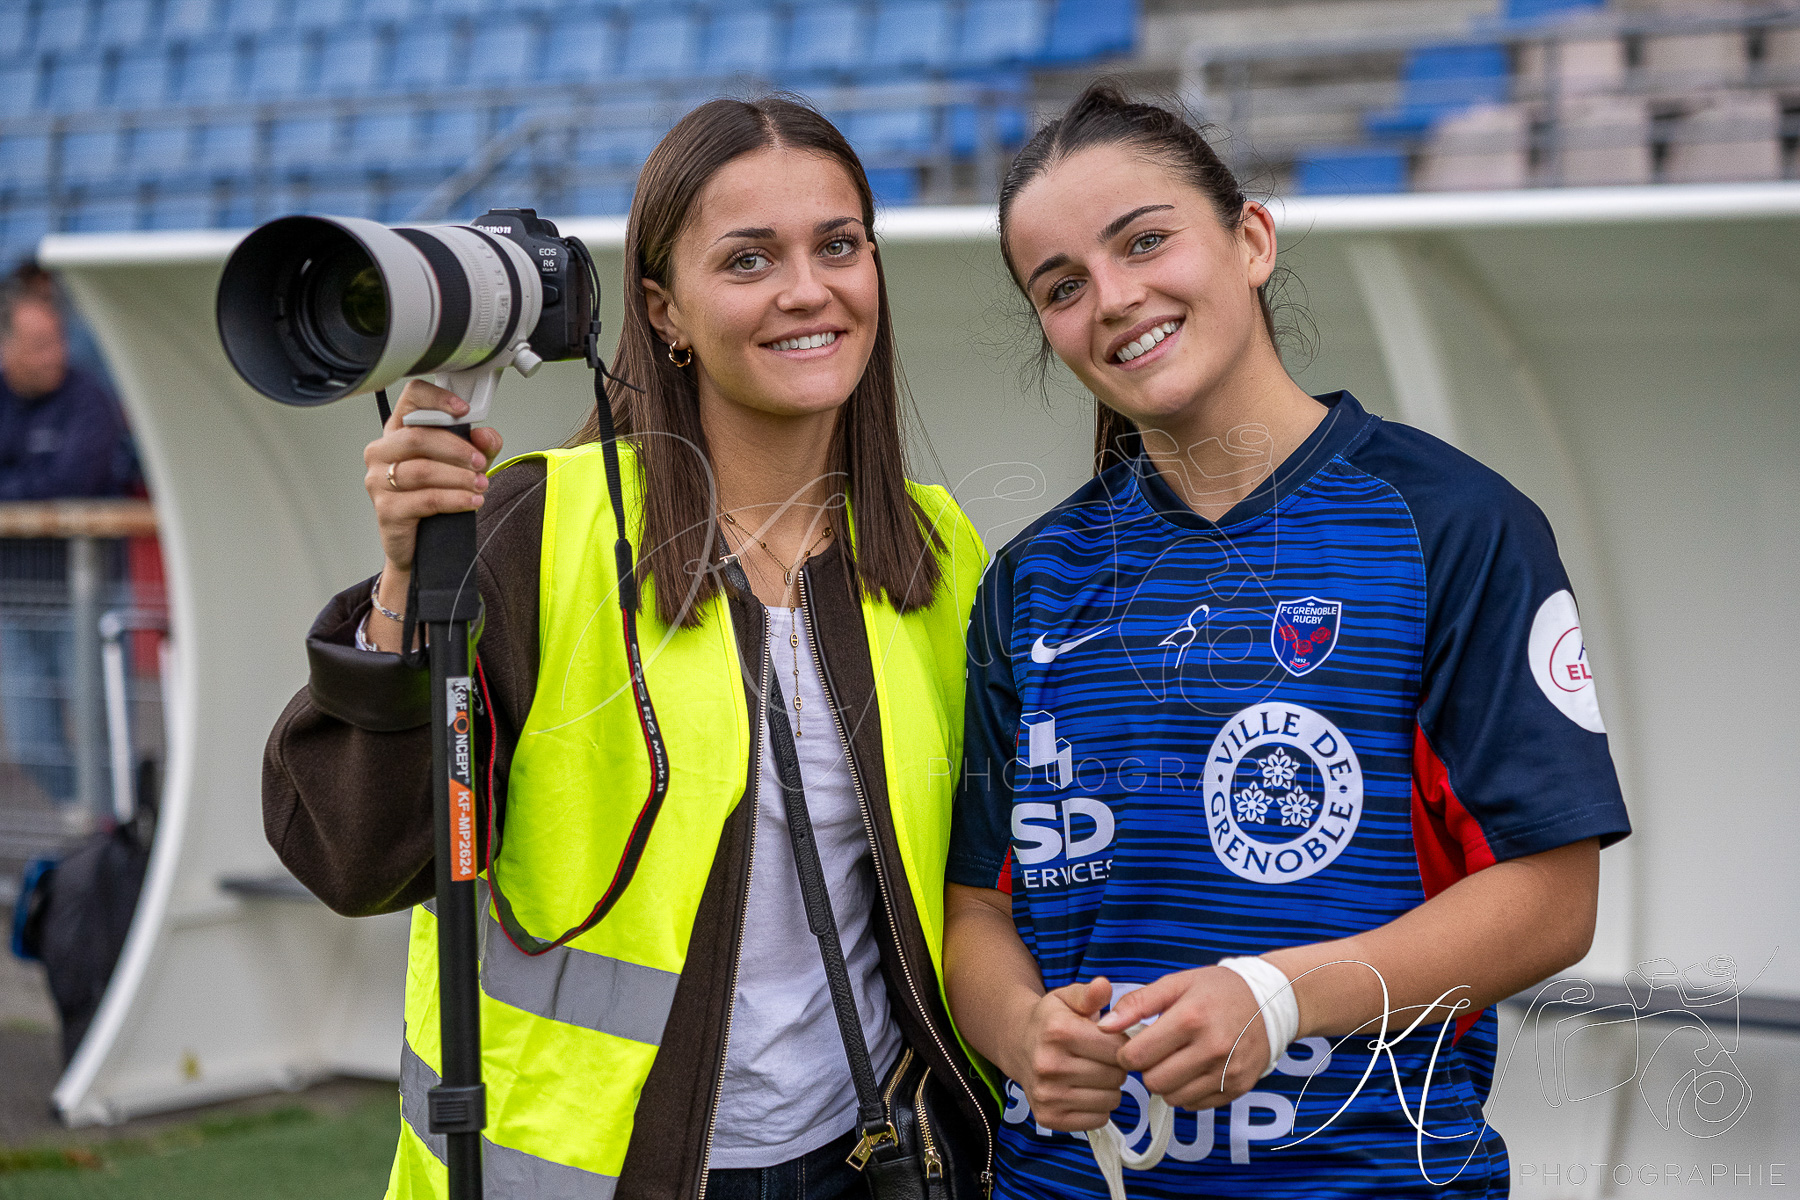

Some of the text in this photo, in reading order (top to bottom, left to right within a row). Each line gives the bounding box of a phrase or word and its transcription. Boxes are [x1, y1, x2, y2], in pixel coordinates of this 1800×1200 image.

[538, 247, 557, 256] EOS
[543, 259, 555, 267] R6
[1292, 615, 1323, 624] RUGBY
[453, 681, 467, 711] K&F
[653, 740, 665, 779] Mark
[1215, 712, 1353, 782] VILLE DE
[457, 790, 472, 876] KF-MP2624
[1011, 797, 1115, 865] SD
[1211, 791, 1354, 875] GRENOBLE
